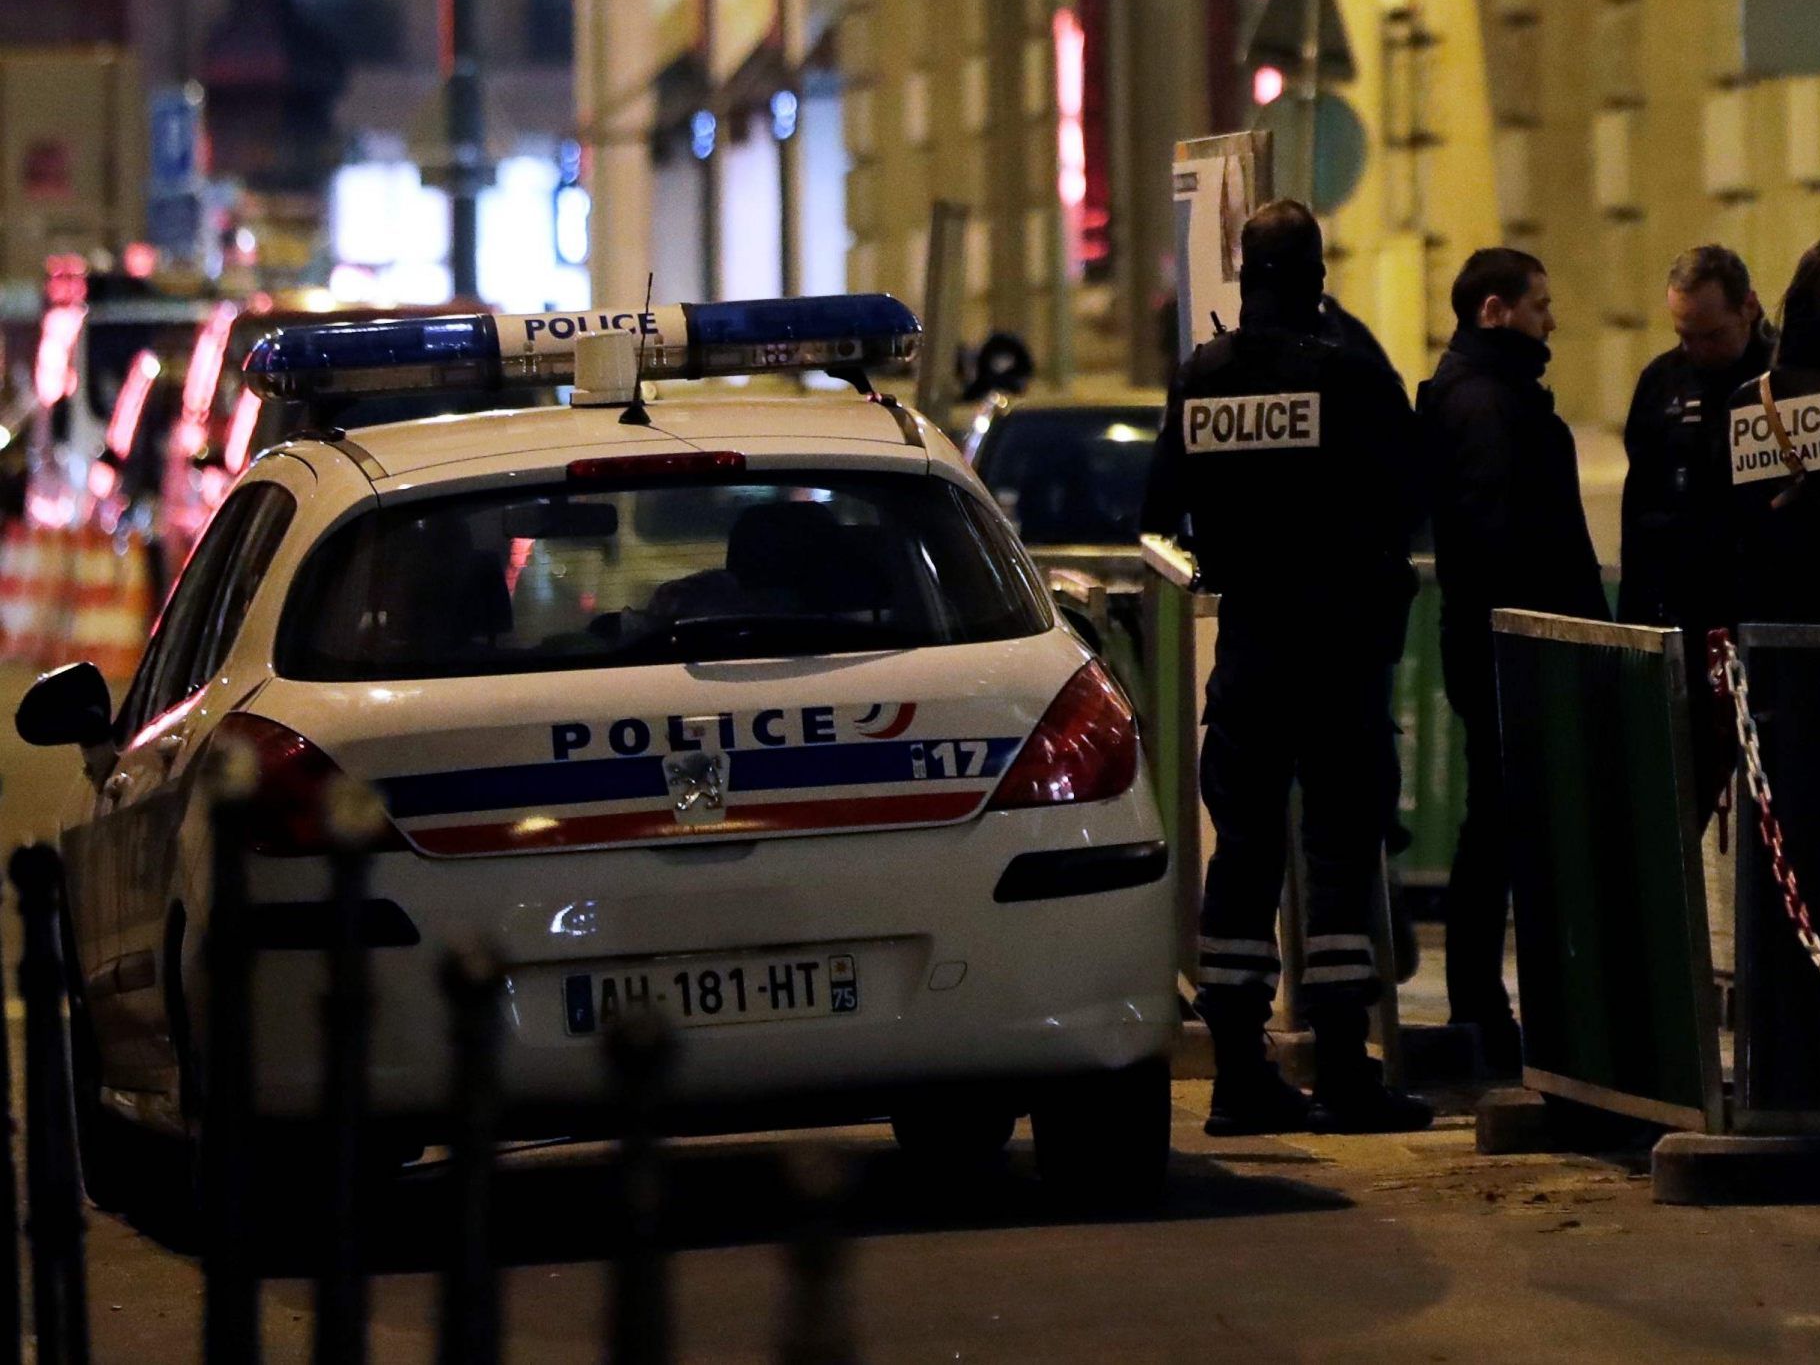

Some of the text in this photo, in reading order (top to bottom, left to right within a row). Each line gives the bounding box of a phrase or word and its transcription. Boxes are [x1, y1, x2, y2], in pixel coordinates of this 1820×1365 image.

[1189, 400, 1311, 445] POLICE
[551, 706, 837, 761] POLICE
[931, 741, 988, 777] 17
[831, 987, 857, 1011] 75
